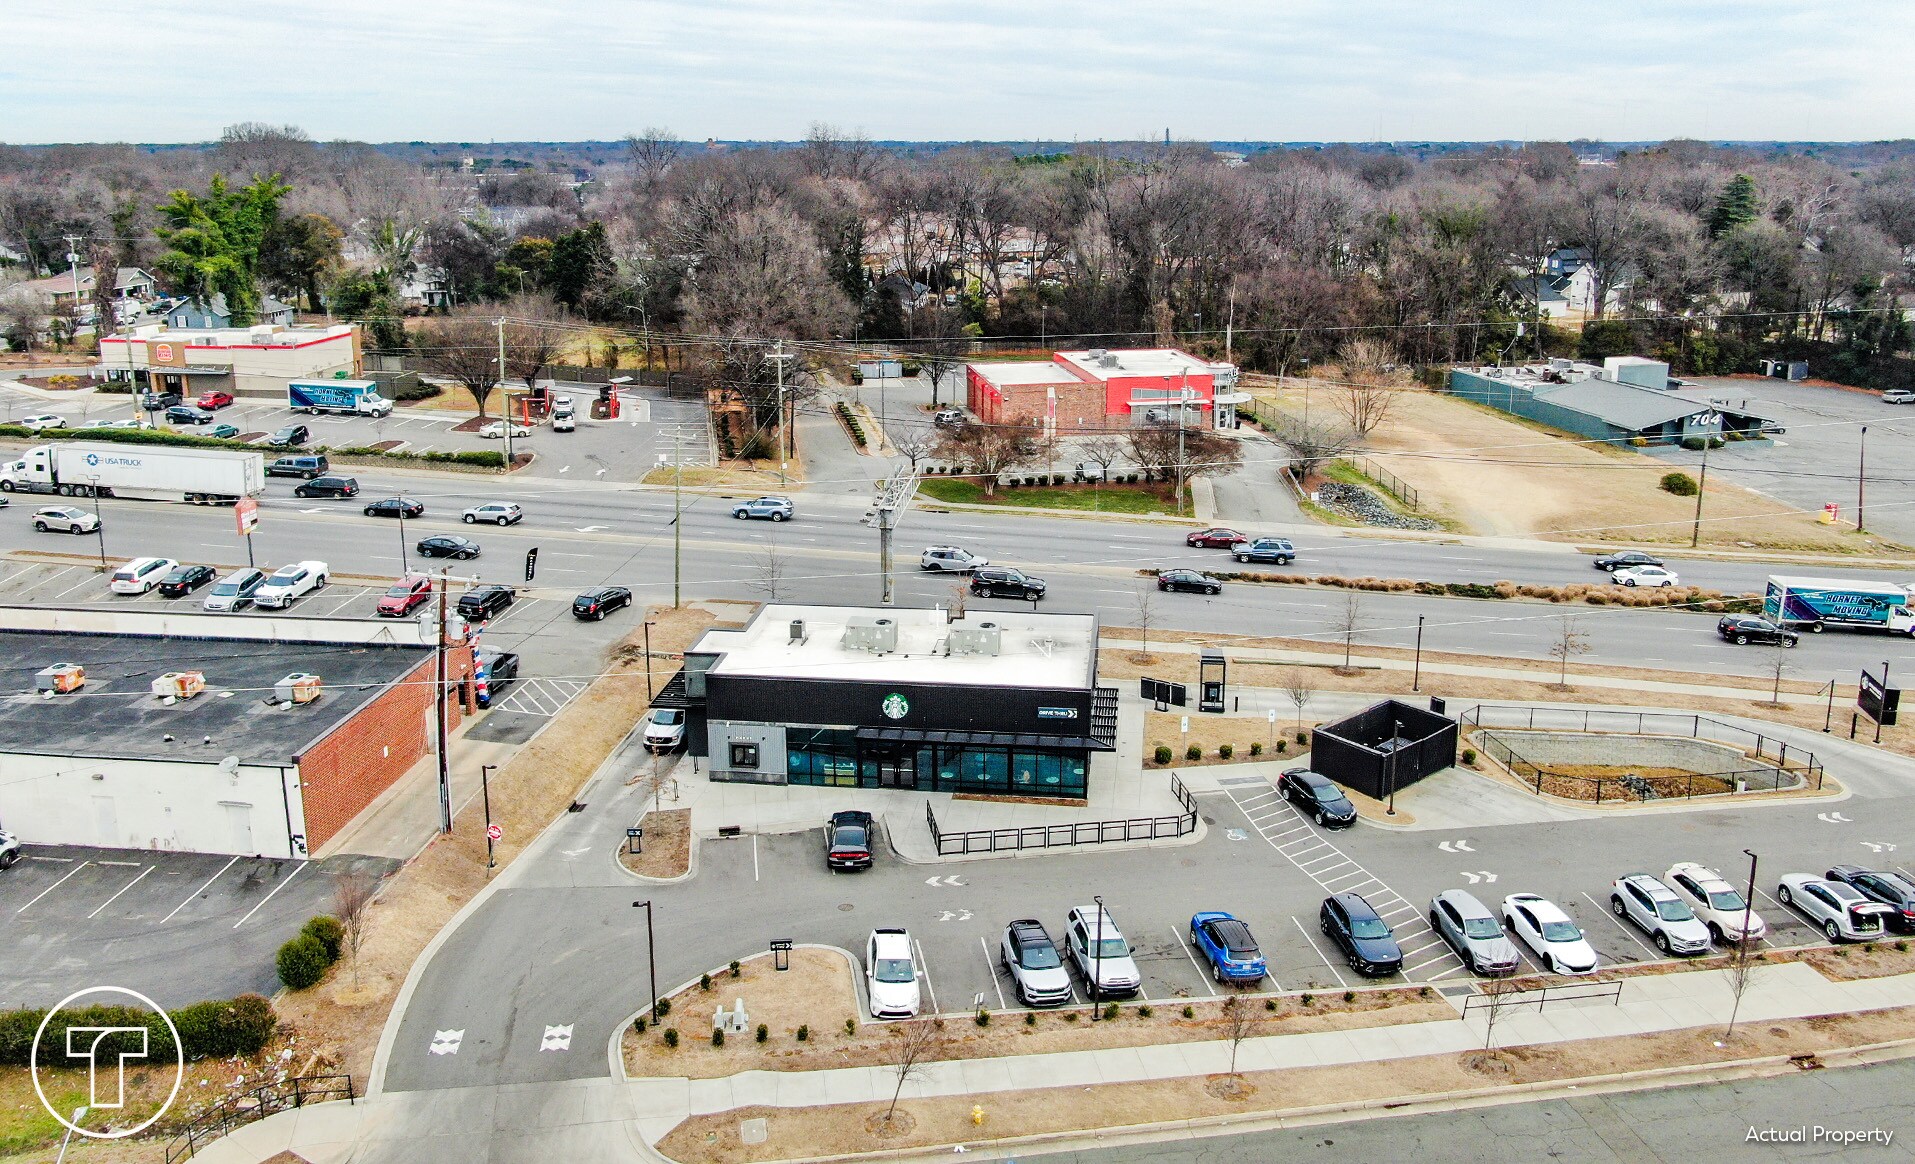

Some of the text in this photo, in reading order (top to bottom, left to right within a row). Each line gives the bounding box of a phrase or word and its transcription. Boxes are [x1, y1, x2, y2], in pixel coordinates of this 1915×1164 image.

[1691, 414, 1721, 426] 704
[104, 457, 142, 466] USA TRUCK
[1825, 594, 1861, 604] HORNET
[1832, 605, 1869, 616] MOVING
